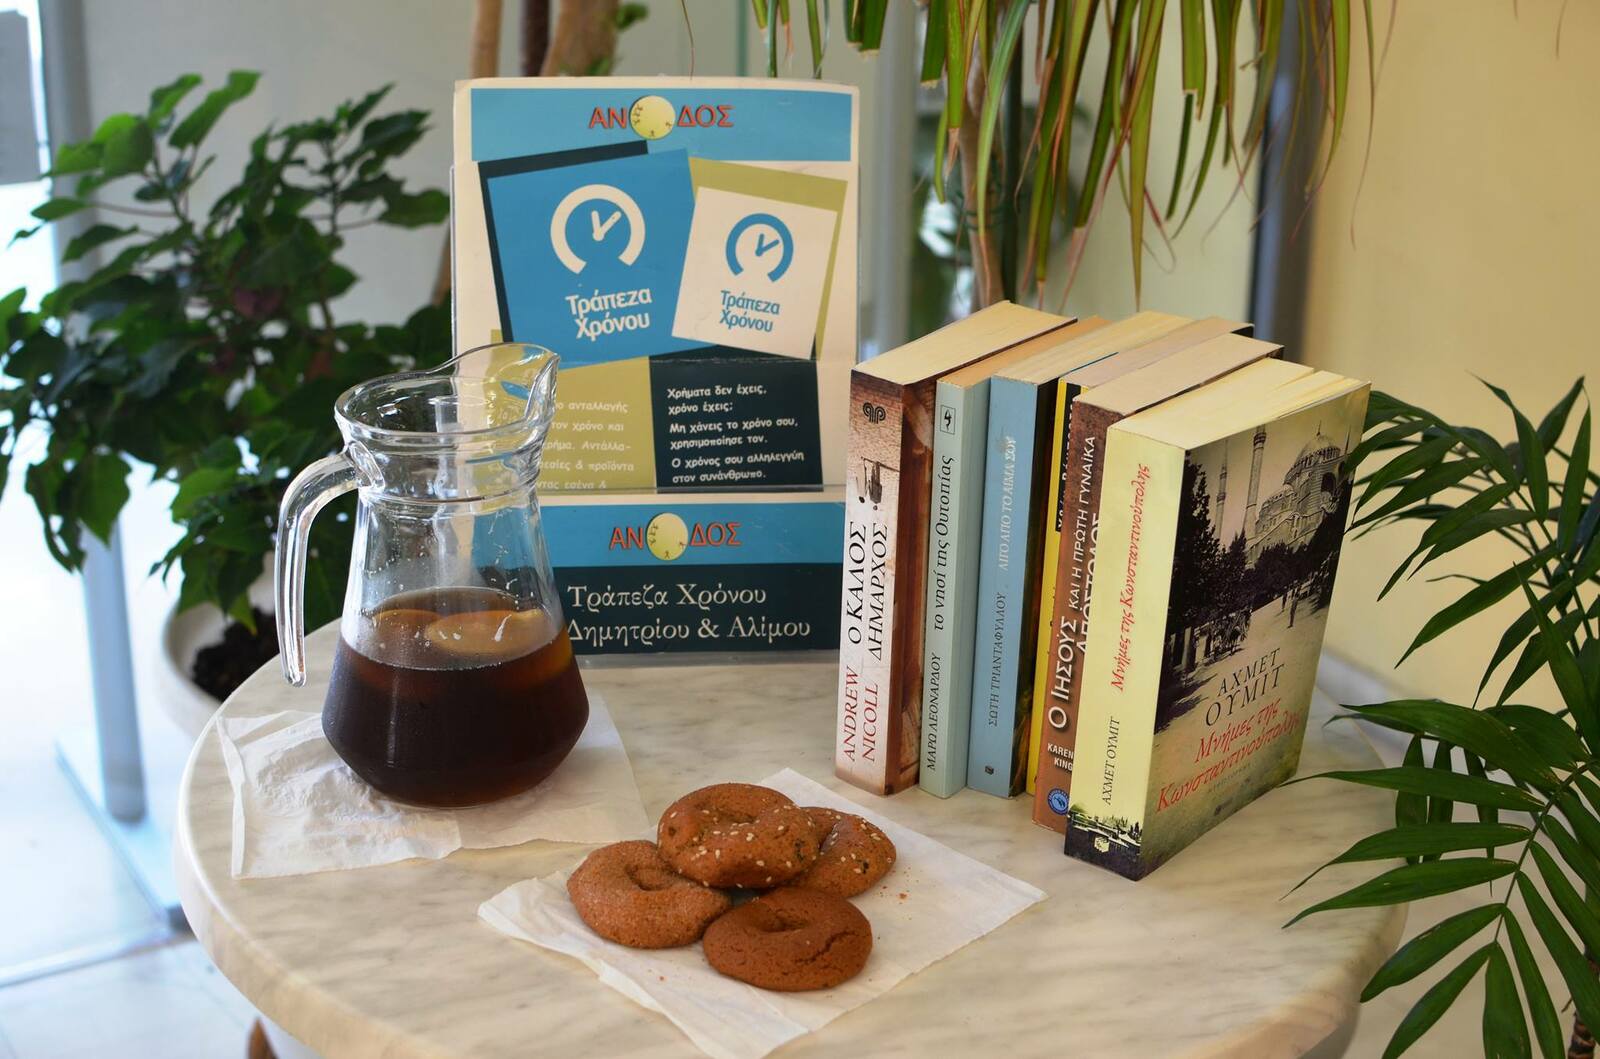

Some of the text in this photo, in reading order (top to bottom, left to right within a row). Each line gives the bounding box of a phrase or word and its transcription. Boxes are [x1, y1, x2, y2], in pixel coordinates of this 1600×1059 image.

[565, 287, 652, 318] Τράπεζα
[720, 290, 780, 316] Τράπεζα
[574, 312, 650, 341] Χρόνου
[719, 308, 774, 333] Χρόνου
[667, 386, 711, 400] Χρήματα
[714, 385, 733, 396] δεν
[568, 401, 630, 413] ανταλλαγής
[668, 403, 698, 415] χρόνο
[572, 420, 604, 432] χρόνο
[607, 422, 624, 431] και
[669, 422, 686, 434] Μη
[689, 421, 723, 434] χάνεις
[726, 421, 738, 430] το
[742, 417, 772, 430] χρόνο
[543, 439, 575, 450] ρήμα.
[670, 435, 743, 450] χρησιμοποίησε
[575, 460, 583, 470] &
[588, 460, 635, 473] προϊόντα
[671, 450, 805, 469] Ο χρόνος σου αλληλεγγύη
[672, 469, 767, 483] στον συνάνθρωπο.
[1002, 496, 1013, 512] ΤΟ
[999, 515, 1011, 543] ΑΠΟ
[932, 455, 955, 631] το νησί της Ουτοπίας
[846, 521, 867, 645] Ο ΚΑΛΟΣ
[1071, 566, 1083, 579] Η
[1111, 463, 1151, 692] Μνήμες της Κωνσταντινούπολης
[567, 582, 767, 613] Τράπεζα Χρόνου
[868, 522, 888, 661] ΔΗΜΑΡΧΟΣ
[1068, 582, 1081, 609] ΚΑΙ
[566, 615, 811, 647] Δημητρίου & Αλίμου
[988, 592, 1006, 727] ΣΩΤΗ ΤΡΙΑΝΤΑΦΥΛΛΟΥ
[1217, 647, 1280, 698] ΑΧΜΕΤ
[1205, 663, 1285, 727] ΟΥΜΙΤ
[843, 665, 859, 763] ANDREW
[862, 682, 878, 763] NICOLL
[926, 652, 942, 771] ΜΑΡΩ ΛΕΟΝΑΡΔΟΥ
[1047, 706, 1067, 729] Ο
[1194, 698, 1281, 764] Μνήμες της
[1047, 742, 1075, 760] KAREN
[1054, 756, 1074, 772] KING
[1102, 716, 1121, 805] ΑΧΜΕΤ ΟΥΜΙΤ
